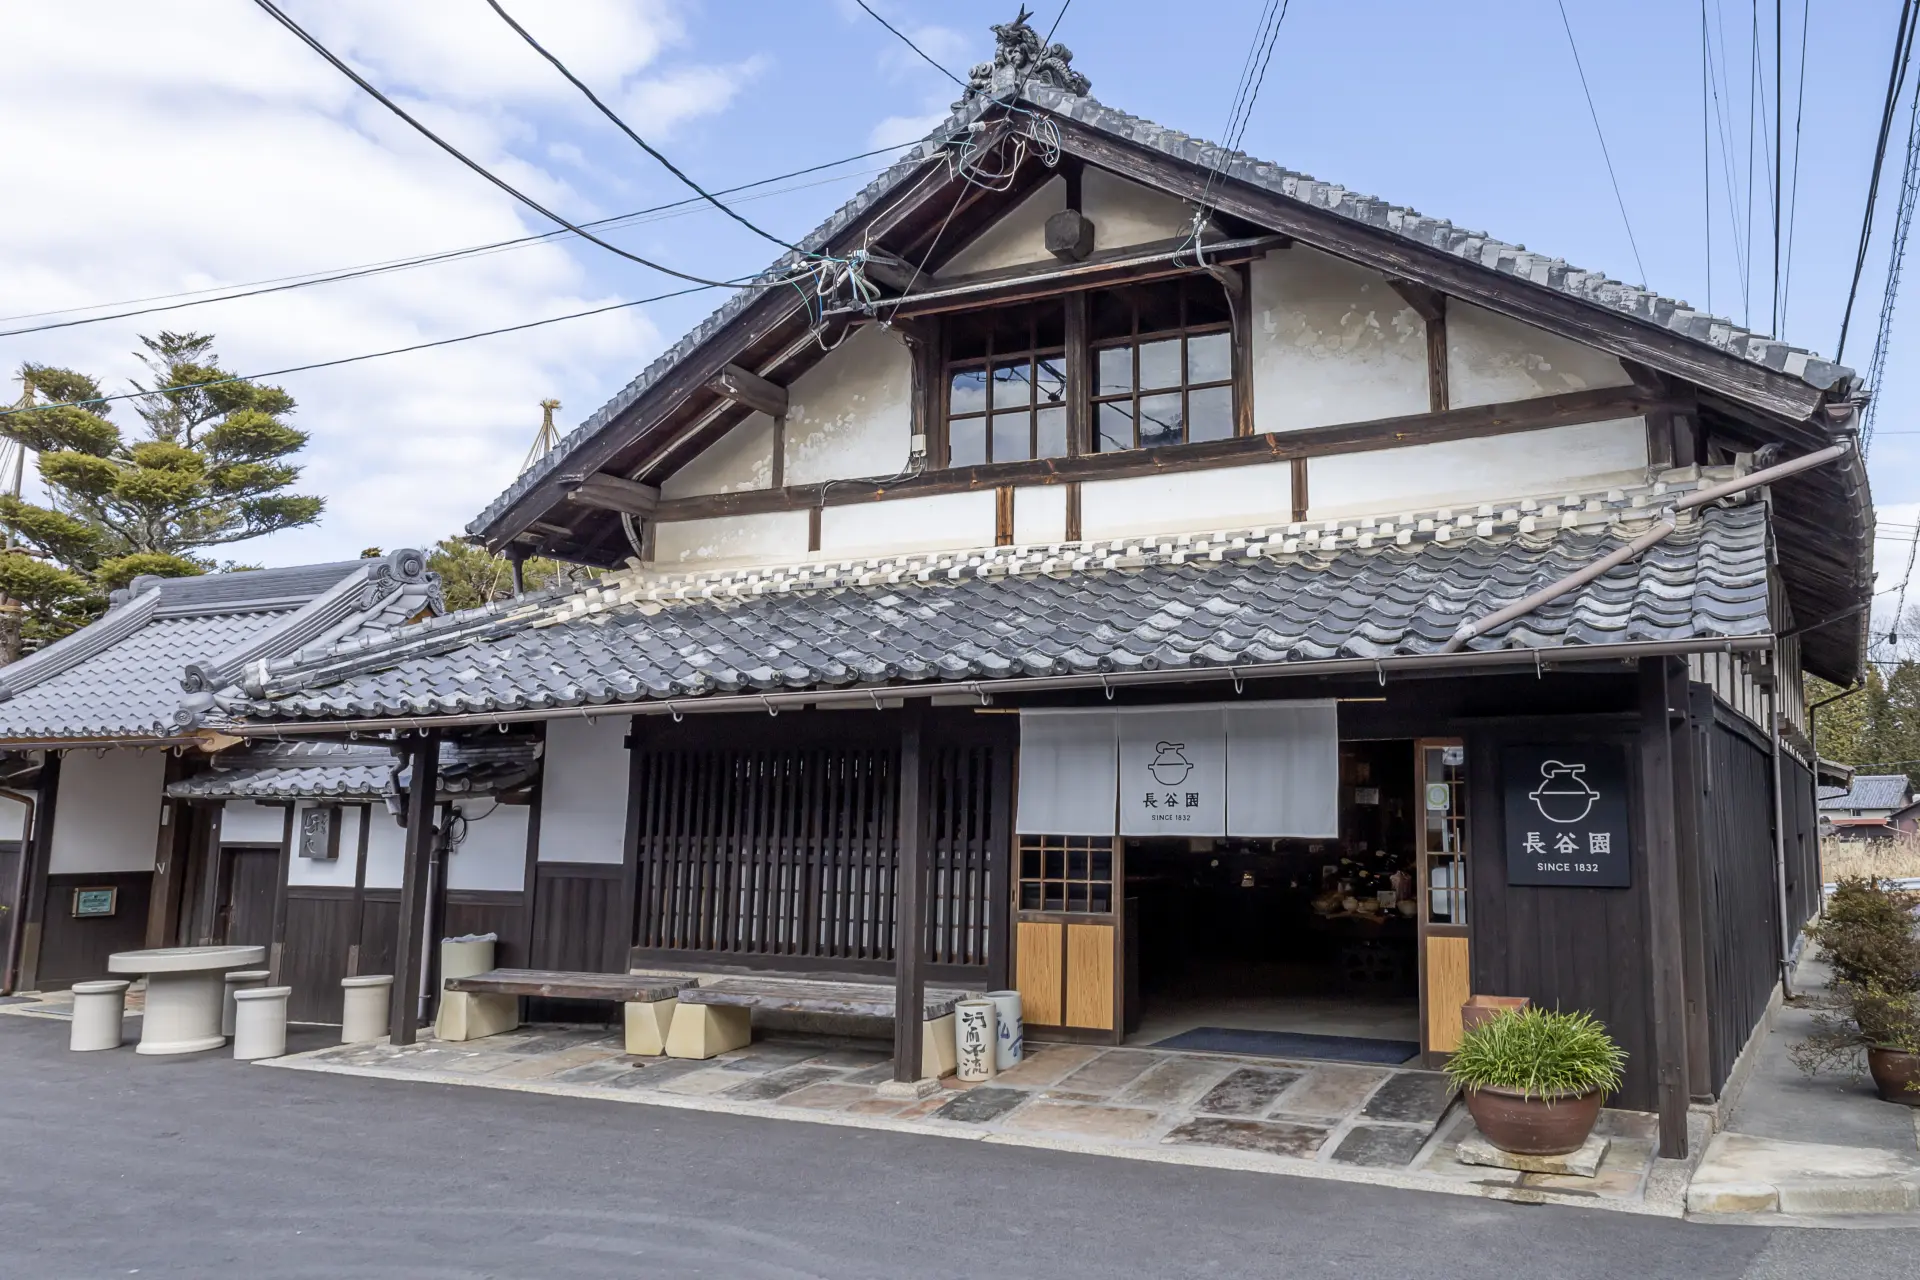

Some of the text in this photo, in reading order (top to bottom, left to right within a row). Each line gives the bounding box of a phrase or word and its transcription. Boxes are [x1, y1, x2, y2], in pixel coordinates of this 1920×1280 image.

[1142, 792, 1199, 808] 長谷園
[1522, 831, 1611, 855] 長谷園
[1537, 862, 1599, 872] SINCE 1832
